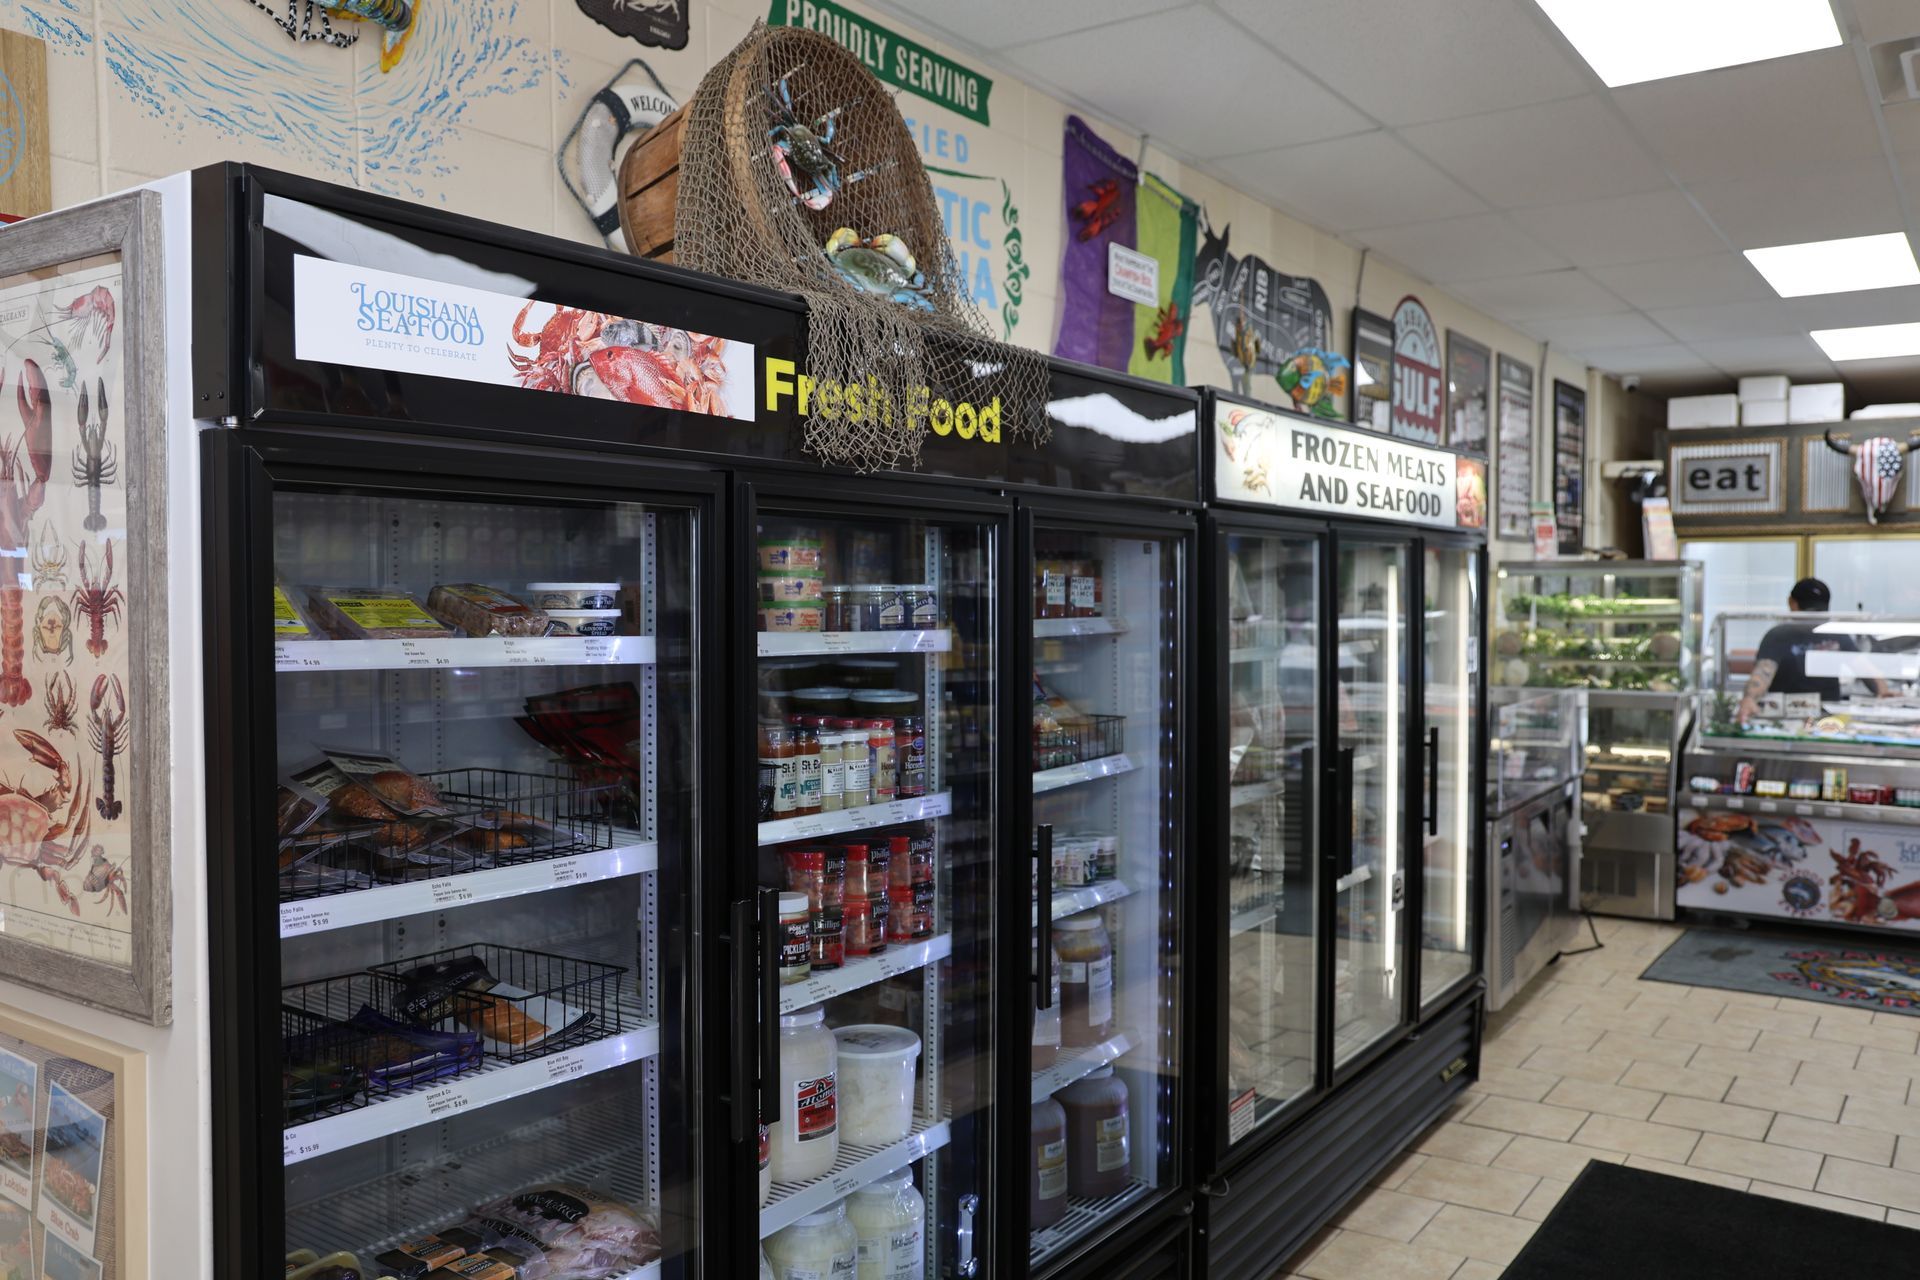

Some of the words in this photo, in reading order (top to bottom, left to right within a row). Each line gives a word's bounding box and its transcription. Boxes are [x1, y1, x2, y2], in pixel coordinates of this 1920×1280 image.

[786, 0, 887, 71] PROUDLY
[895, 45, 978, 111] SERVING
[350, 282, 480, 327] LOUISIANA
[1254, 268, 1269, 312] RIB
[357, 303, 485, 346] SEAFOOD
[365, 338, 404, 351] PLENTY
[407, 344, 421, 353] TO
[423, 346, 478, 361] CELEBRATE
[766, 356, 893, 429] Fresh
[906, 383, 1001, 443] Food
[1291, 429, 1379, 474] FROZEN
[1387, 451, 1446, 487] MEATS
[1688, 463, 1761, 492] eat
[1300, 472, 1348, 505] AND
[1356, 481, 1442, 518] SEAFOOD
[813, 918, 841, 933] Phillips
[4, 1172, 28, 1198] Lobster
